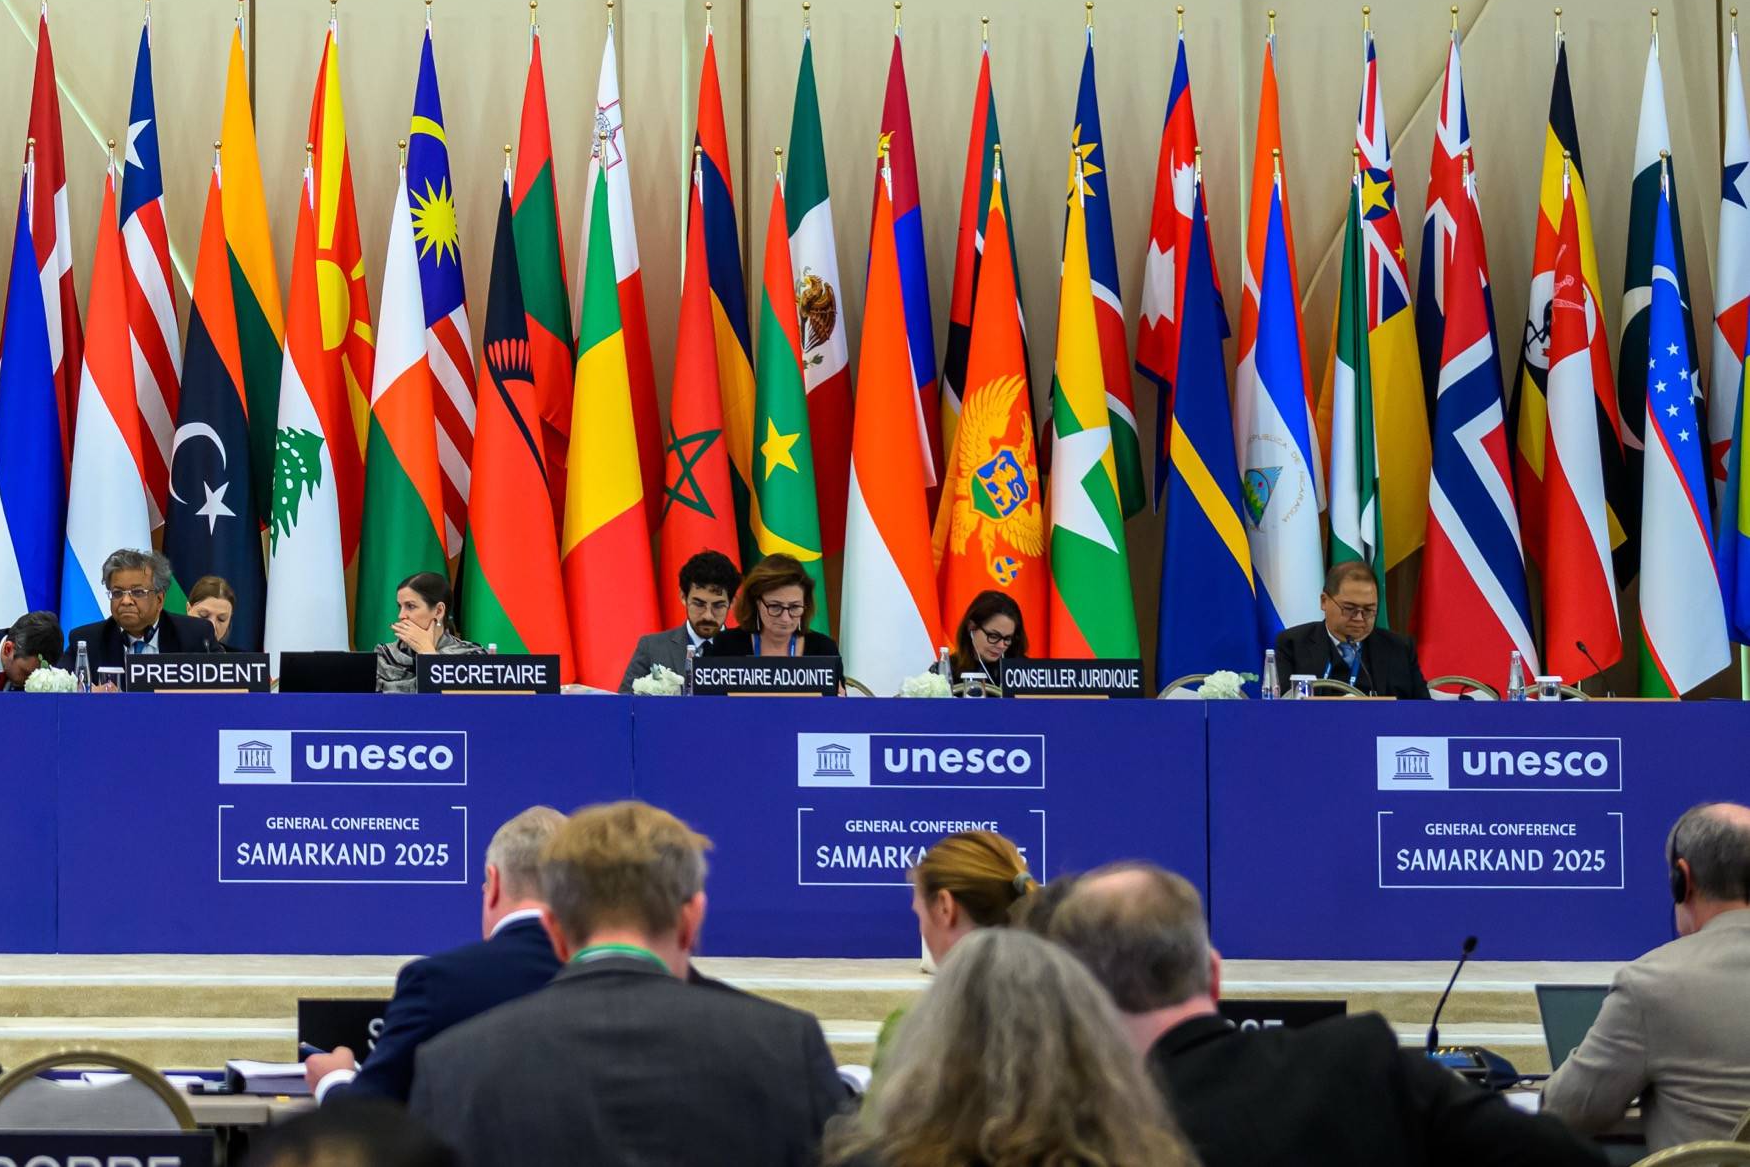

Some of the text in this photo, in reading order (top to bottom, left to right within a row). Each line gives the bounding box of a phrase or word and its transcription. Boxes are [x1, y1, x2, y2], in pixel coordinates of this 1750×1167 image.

[130, 662, 267, 684] PRESIDENT
[429, 664, 547, 684] SECRETAIRE
[695, 668, 834, 686] SECRETAIRE ADJOINTE
[1005, 668, 1140, 688] CONSEILLER JURIDIQUE
[305, 744, 454, 771] unesco
[884, 747, 1032, 774] unesco
[1462, 751, 1608, 777] unesco
[265, 817, 420, 831] GENERAL CONFERENCE
[845, 820, 998, 833] GENERAL CONFERENCE
[1424, 823, 1577, 837] GENERAL CONFERENCE
[236, 842, 449, 867] SAMARKAND 2025
[1396, 848, 1606, 872] SAMARKAND 2025
